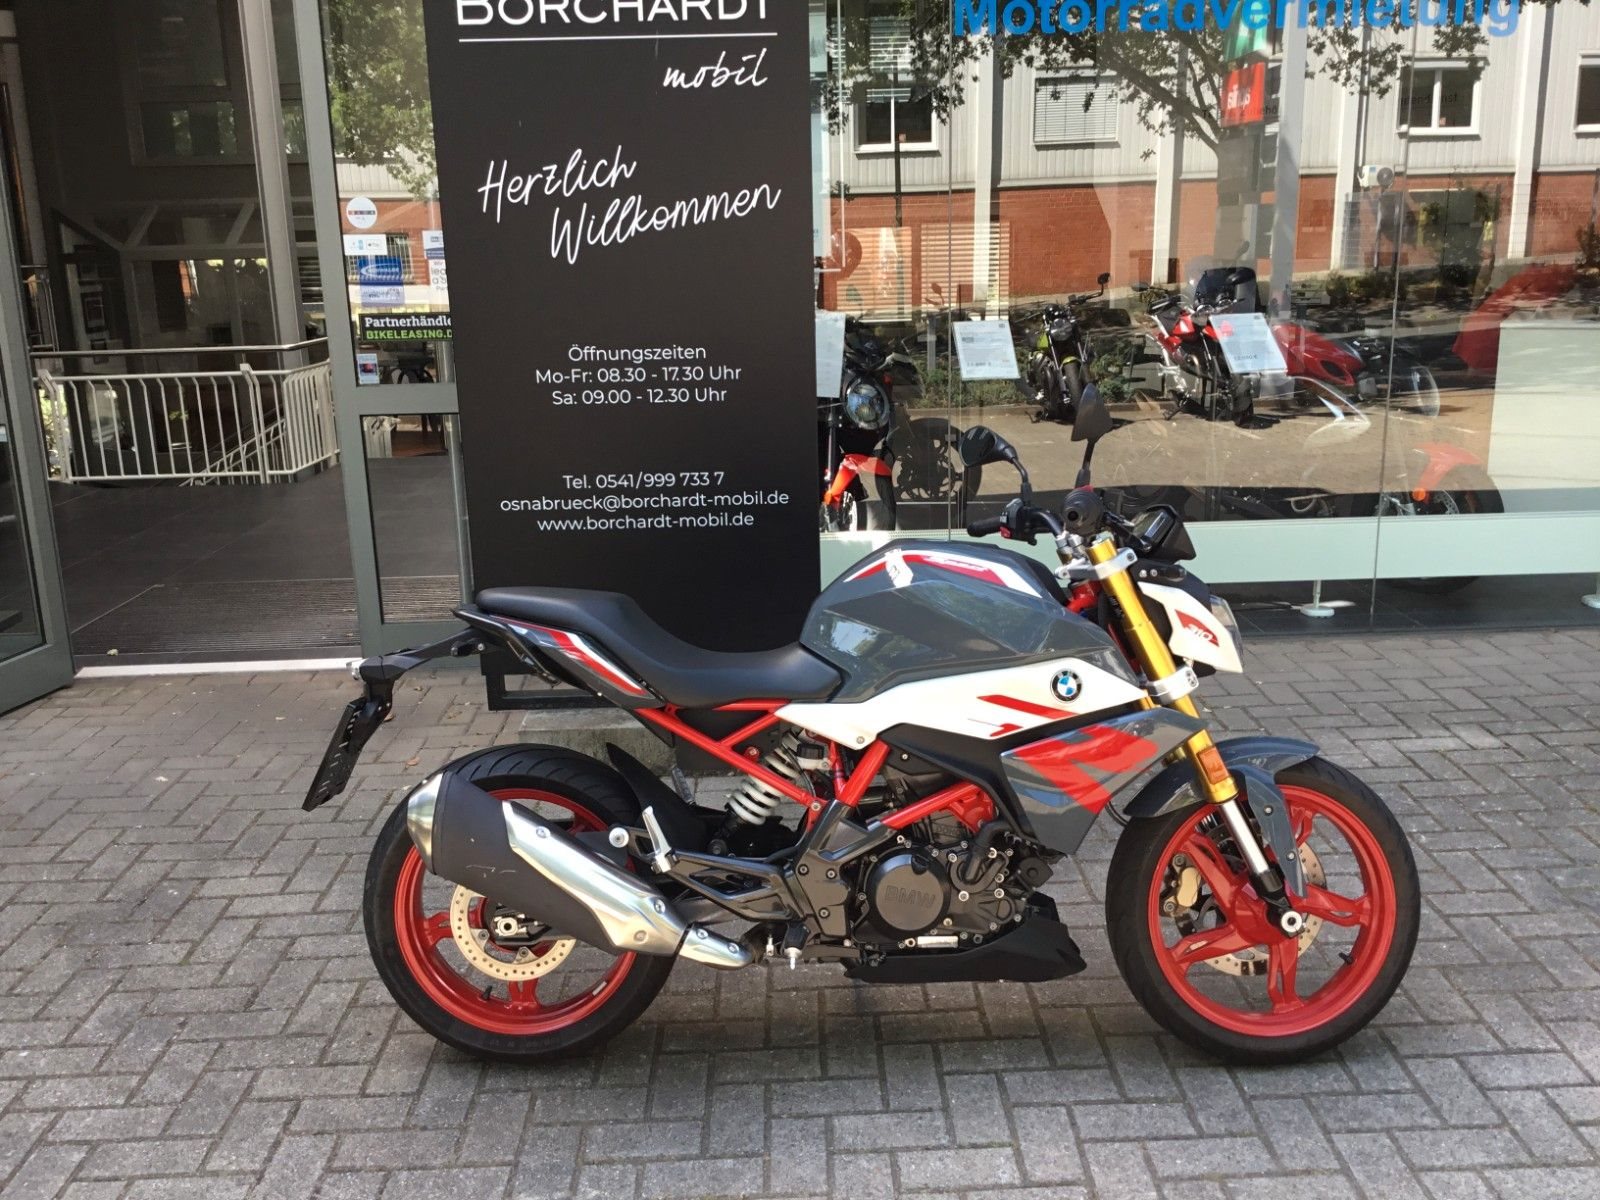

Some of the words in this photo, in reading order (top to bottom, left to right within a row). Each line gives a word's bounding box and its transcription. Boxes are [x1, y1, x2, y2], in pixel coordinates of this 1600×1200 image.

[456, 0, 767, 25] BORCHARDT
[953, 0, 1520, 37] Motorradvermietung
[662, 47, 769, 89] mobil
[477, 145, 638, 224] Herzlich
[551, 184, 782, 265] Willkommen
[568, 343, 707, 364] Öffnungszeiten
[535, 369, 593, 384] Mo-Fr:
[597, 367, 647, 383] 08.30
[661, 365, 704, 382] 17.30
[709, 365, 742, 381] Uhr
[551, 390, 578, 406] Sa:
[581, 389, 632, 404] 09.00
[646, 387, 690, 403] 12.30
[694, 386, 728, 402] Uhr
[562, 474, 592, 489] Tel.
[595, 471, 676, 489] 0541/999
[679, 471, 710, 487] 733
[713, 471, 725, 486] 7
[500, 490, 790, 513] osnabrueck@borchardt-mobil.de
[536, 511, 755, 531] www.borchardt-mobil.de
